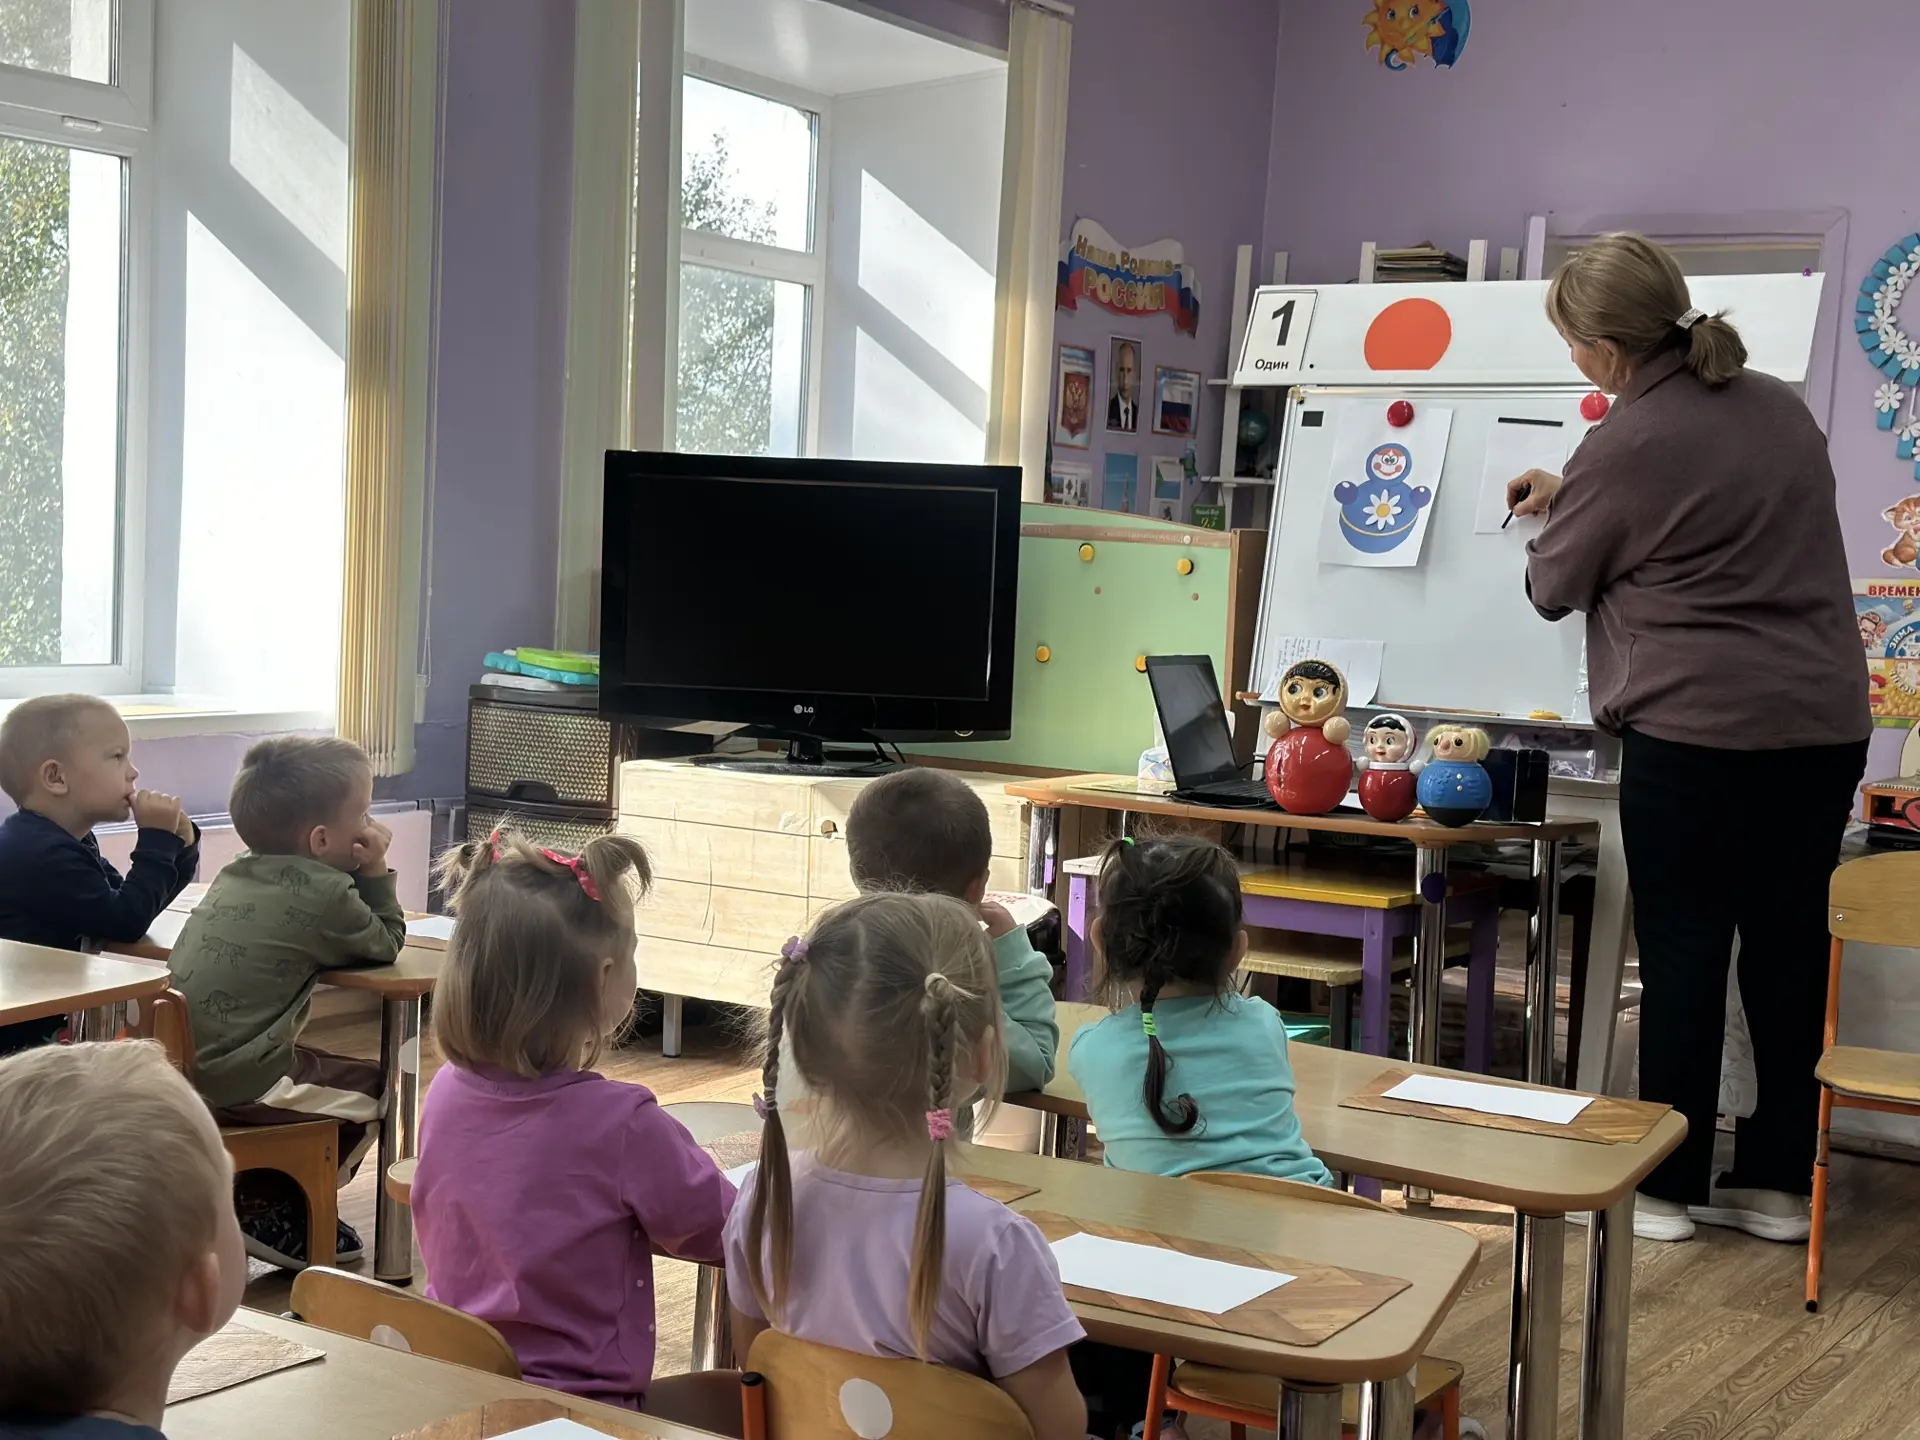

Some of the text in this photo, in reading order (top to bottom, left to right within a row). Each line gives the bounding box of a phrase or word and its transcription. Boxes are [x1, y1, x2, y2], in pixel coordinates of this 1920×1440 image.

[1075, 234, 1117, 271] Наша
[1083, 267, 1166, 311] РОССИЯ
[1272, 300, 1296, 347] 1
[1255, 359, 1289, 372] Один
[1889, 625, 1915, 650] ЗИМА
